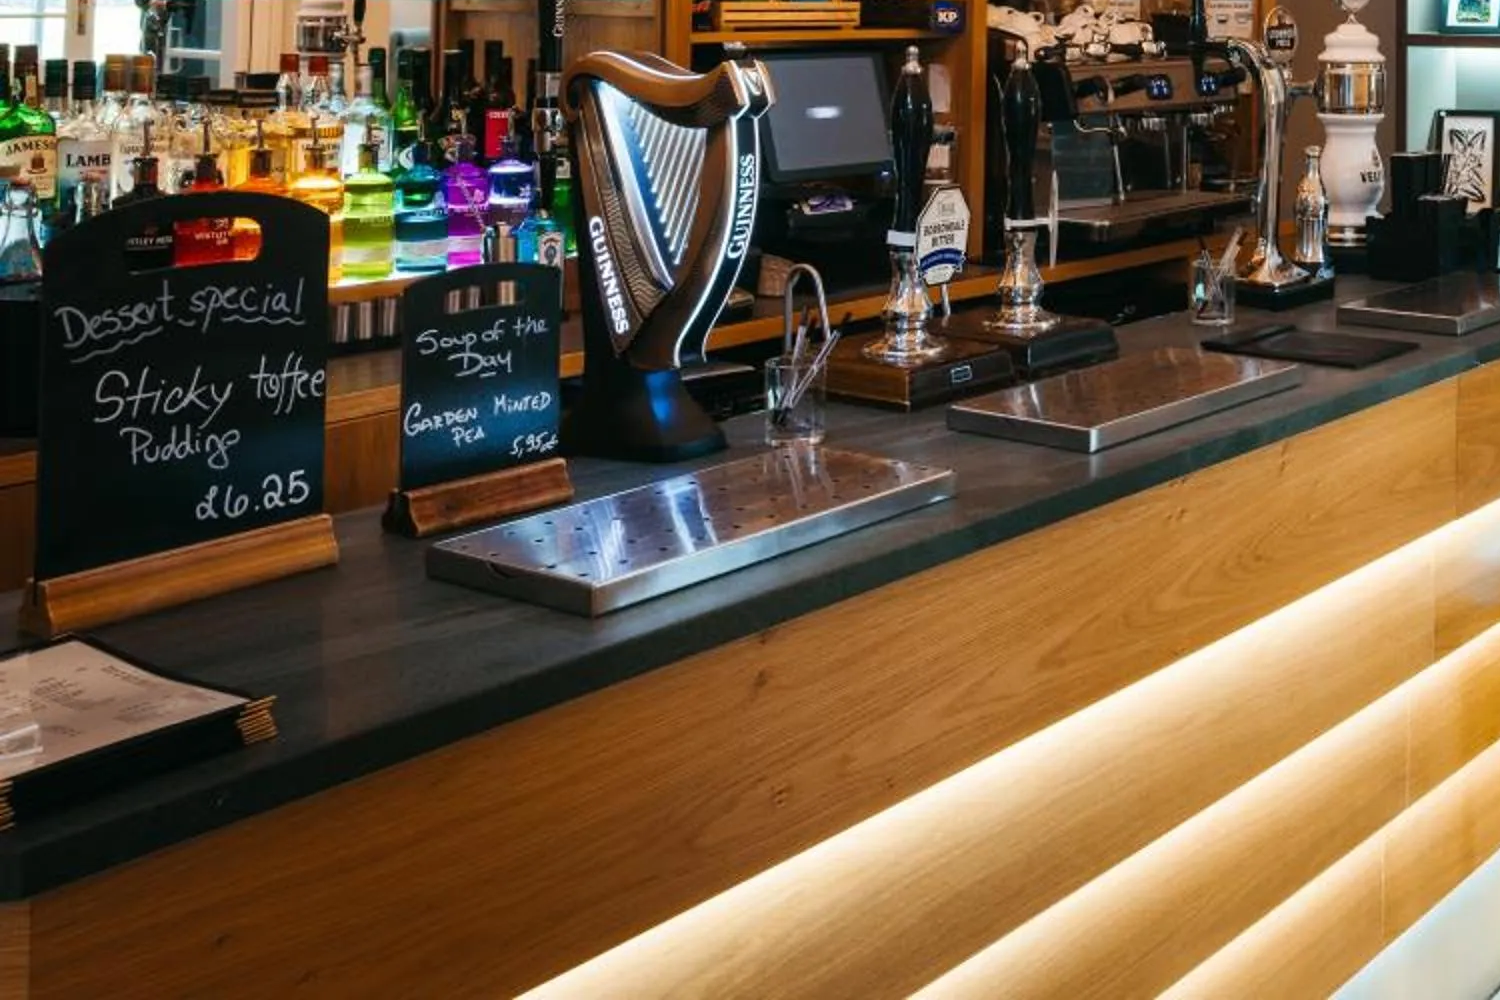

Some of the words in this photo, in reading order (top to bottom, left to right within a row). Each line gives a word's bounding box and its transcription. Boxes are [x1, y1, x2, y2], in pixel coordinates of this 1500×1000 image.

[938, 8, 959, 24] KP
[726, 153, 756, 260] GUINNESS
[588, 215, 630, 335] GUINNESS
[54, 279, 174, 348] Dessert
[189, 277, 305, 334] special
[415, 329, 477, 355] Soup
[481, 319, 506, 342] of
[512, 315, 549, 338] the
[447, 350, 513, 378] Day
[93, 366, 233, 430] Sticky
[249, 351, 325, 416] toffee
[119, 424, 241, 470] Pudding
[451, 425, 485, 448] PEA
[194, 469, 311, 521] £6.25
